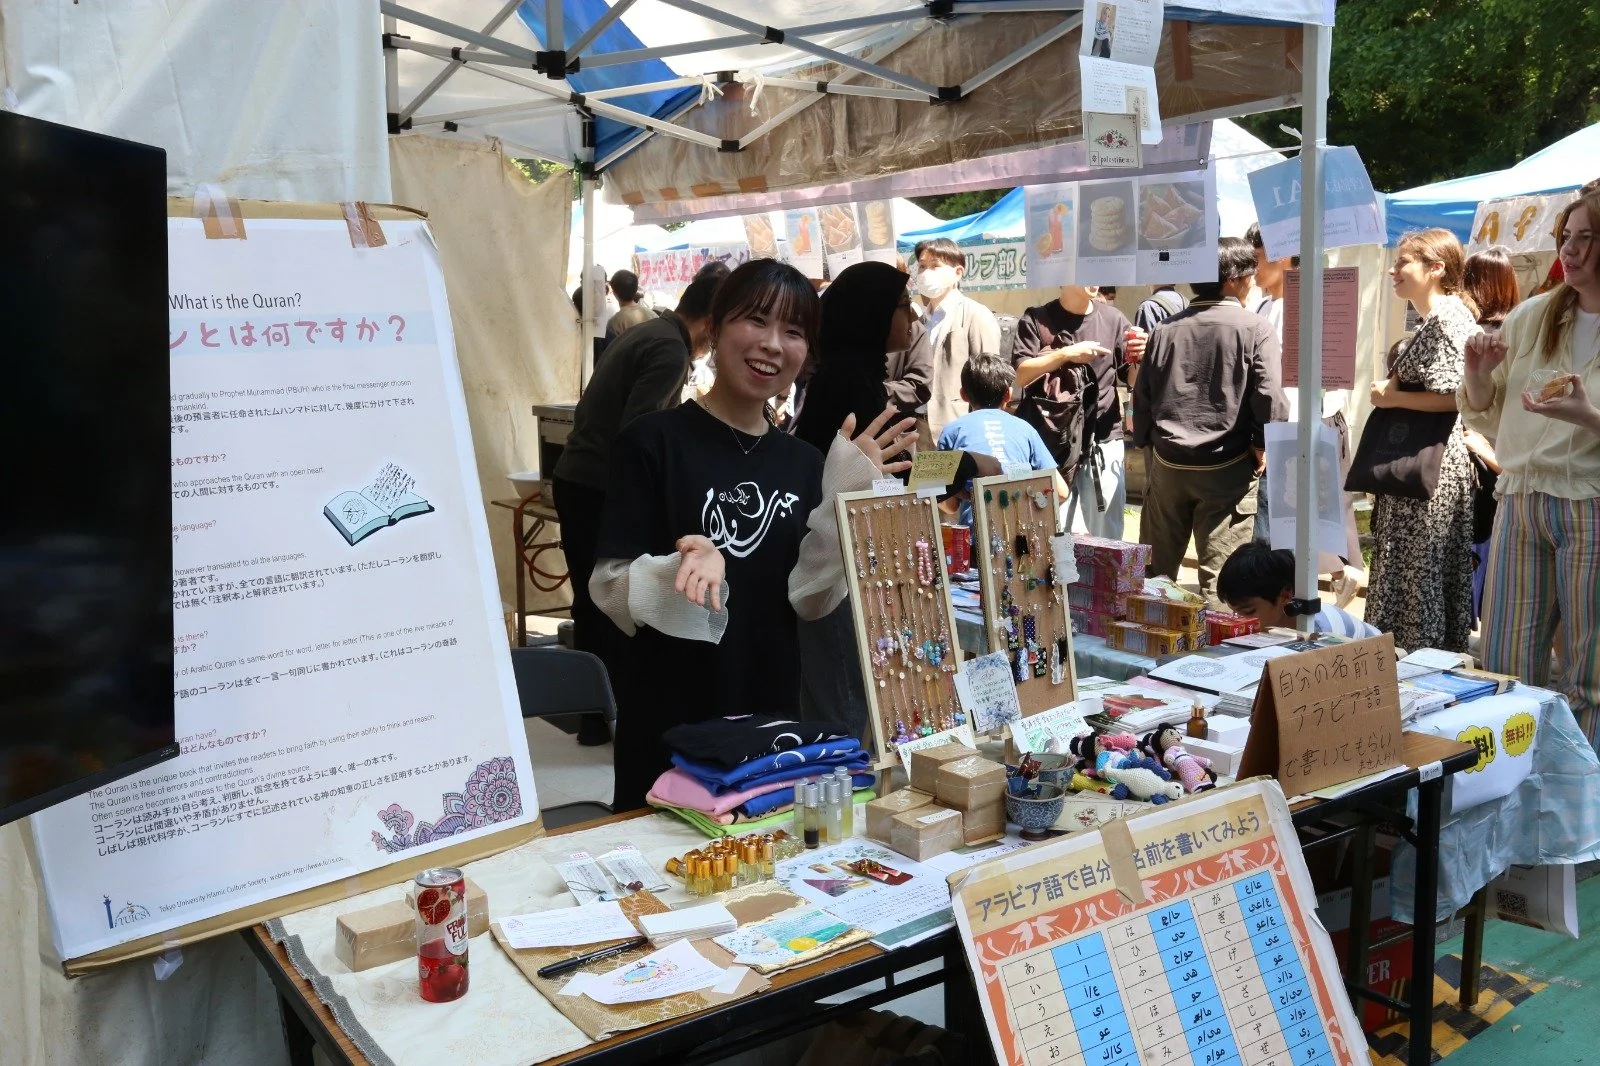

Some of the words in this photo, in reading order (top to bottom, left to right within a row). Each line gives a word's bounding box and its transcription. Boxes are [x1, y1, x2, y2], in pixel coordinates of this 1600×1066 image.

[170, 293, 208, 310] What
[210, 293, 224, 309] is
[225, 293, 249, 309] the
[252, 292, 302, 309] Quran?
[178, 391, 210, 403] gradually
[219, 389, 246, 399] Prophet
[310, 384, 325, 393] who
[331, 383, 343, 391] the
[176, 402, 209, 412] mankind.
[173, 479, 189, 488] who
[189, 476, 231, 488] approaches
[231, 474, 243, 482] the
[243, 472, 265, 482] Quran
[265, 470, 279, 479] with
[289, 467, 306, 478] open
[179, 519, 217, 532] language?
[175, 566, 206, 576] however
[206, 559, 242, 572] translated
[249, 557, 259, 566] all
[259, 556, 271, 564] the
[271, 552, 307, 563] languages.
[185, 630, 209, 642] there?
[189, 663, 214, 675] Arabic
[214, 659, 237, 670] Quran
[246, 649, 284, 664] same-word
[285, 648, 295, 657] for
[314, 642, 331, 651] letter
[332, 639, 341, 648] for
[342, 637, 358, 646] letter
[382, 630, 395, 639] one
[403, 625, 414, 635] the
[1279, 646, 1386, 698] 自分の名前を
[1293, 685, 1381, 732] アラビア語
[177, 735, 195, 747] uran
[194, 728, 217, 741] have?
[88, 784, 104, 800] The
[104, 784, 130, 796] Quran
[138, 779, 152, 788] the
[152, 773, 178, 785] unique
[178, 767, 198, 779] book
[198, 763, 213, 774] that
[213, 759, 237, 771] invites
[237, 756, 250, 765] the
[250, 750, 277, 762] readers
[285, 744, 304, 754] bring
[303, 739, 319, 751] faith
[328, 734, 346, 744] using
[360, 726, 379, 737] ability
[402, 717, 414, 727] and
[414, 714, 437, 724] reason.
[1285, 726, 1392, 778] で書いてもらい
[88, 801, 106, 811] The
[106, 795, 132, 807] Quran
[140, 789, 156, 799] free
[166, 782, 189, 793] errors
[189, 776, 204, 788] and
[204, 767, 256, 784] contradictions.
[91, 811, 114, 823] Often
[115, 804, 144, 817] science
[145, 795, 180, 810] becomes
[187, 787, 215, 799] witness
[224, 782, 236, 794] the
[237, 774, 265, 791] Quran's
[265, 770, 287, 784] divine
[976, 811, 1260, 923] アラビア語で自分名前を書いてみよう
[158, 902, 178, 913] Tokyo
[226, 883, 247, 894] Culture
[1126, 924, 1135, 938] は
[1133, 945, 1140, 957] ひ
[1025, 962, 1035, 975] あ
[1138, 965, 1147, 977] ふ
[1030, 984, 1041, 996] い
[1038, 1003, 1046, 1018] う
[1044, 1024, 1054, 1037] え
[1050, 1045, 1060, 1059] お
[1162, 1045, 1172, 1058] み
